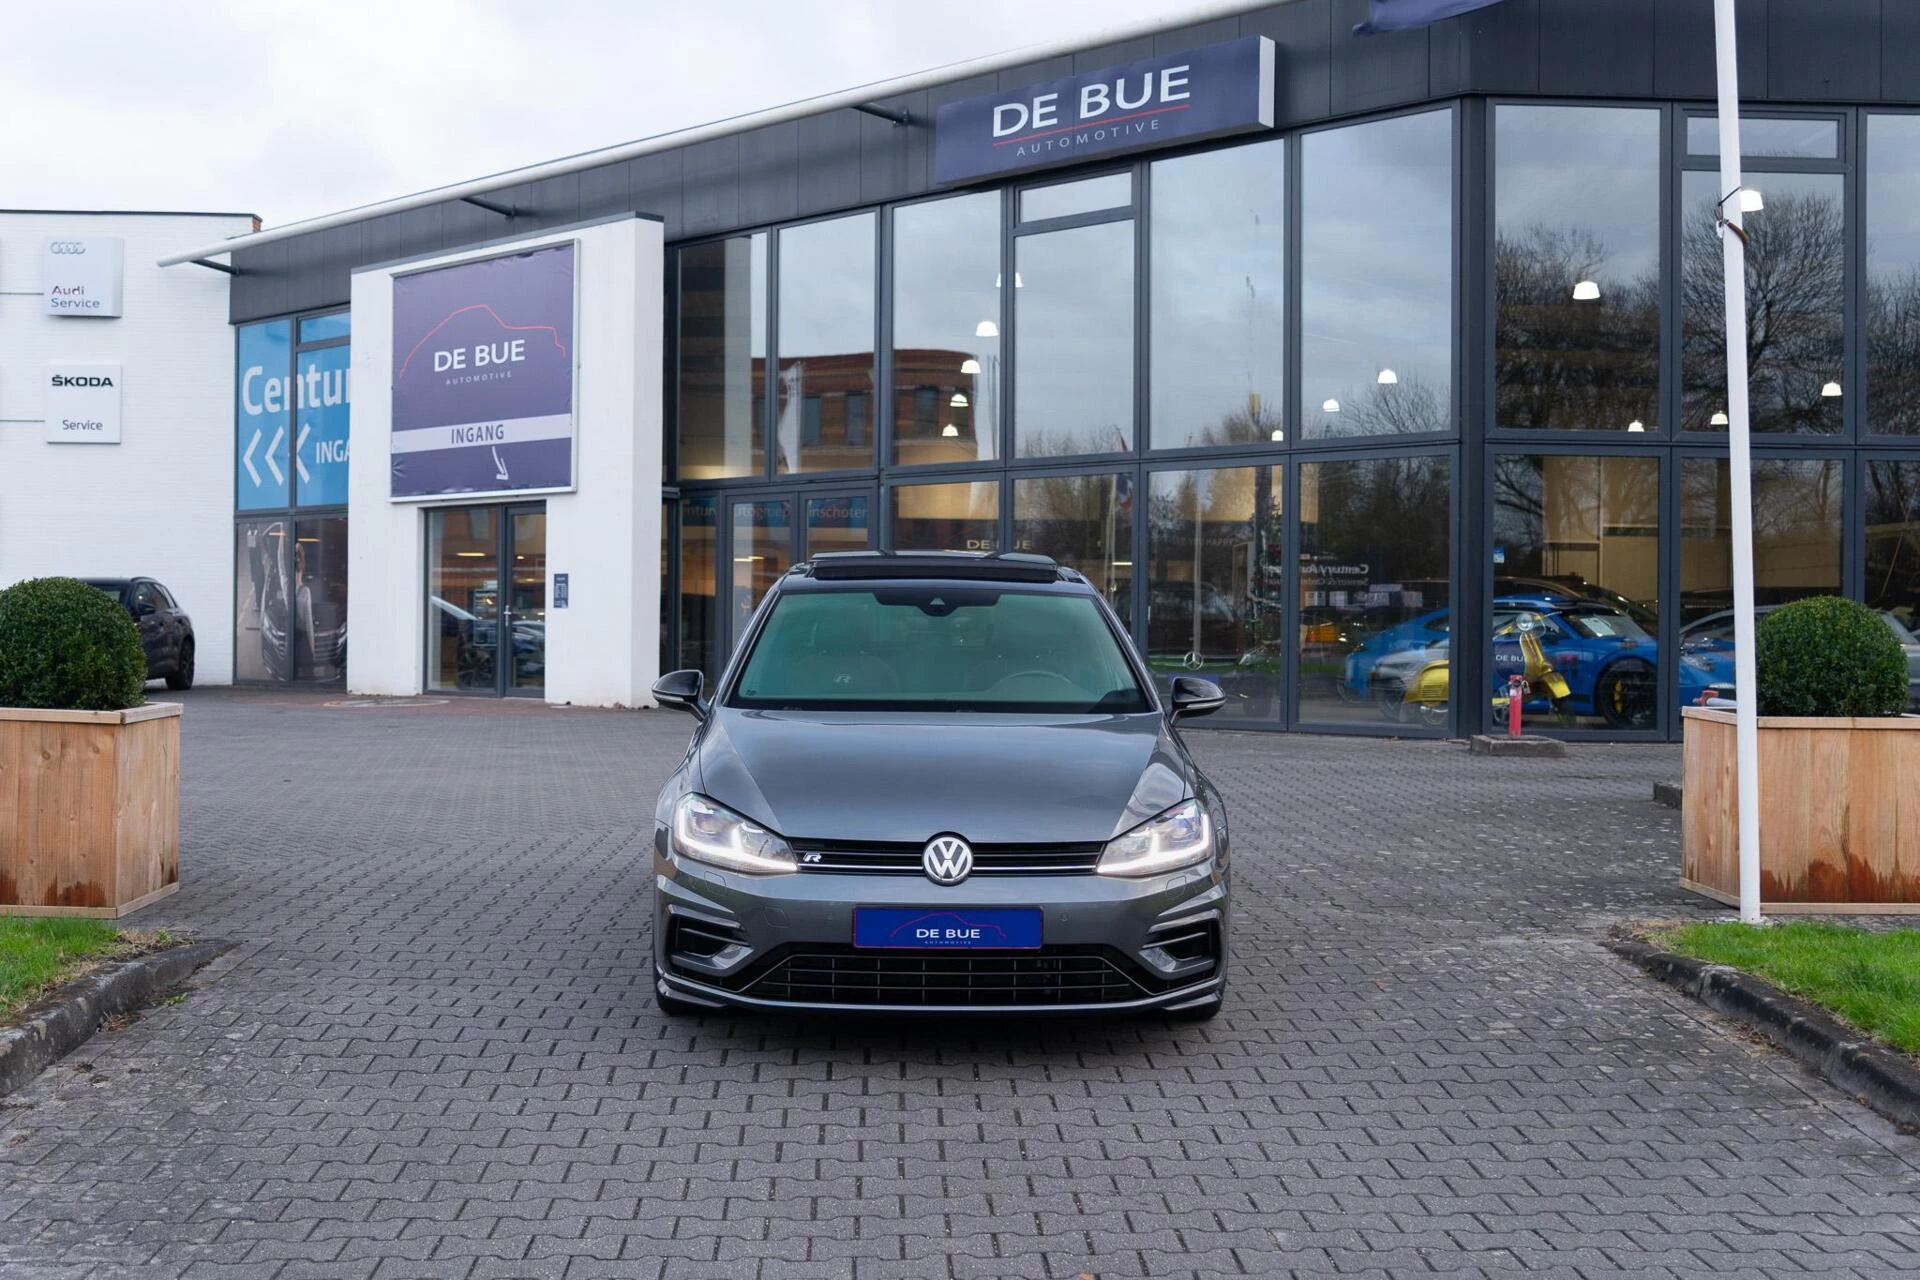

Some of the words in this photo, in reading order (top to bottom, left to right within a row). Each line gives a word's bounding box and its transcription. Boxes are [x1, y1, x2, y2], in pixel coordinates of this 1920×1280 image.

[993, 93, 1059, 138] DE
[1080, 65, 1191, 119] BUE
[1016, 119, 1160, 157] AUTOMOTIVE
[51, 285, 85, 296] Audi
[51, 297, 101, 309] Service
[434, 348, 467, 372] DE
[475, 339, 526, 367] BUE
[51, 374, 114, 388] ŠKODA
[445, 370, 513, 385] AUTOMOTIVE
[242, 363, 351, 416] Centu
[62, 419, 104, 431] Service
[450, 424, 505, 445] INGANG
[315, 439, 350, 465] INGA
[966, 540, 990, 550] DE
[1511, 655, 1525, 663] BU
[802, 852, 822, 863] R
[916, 928, 940, 939] DE
[945, 928, 981, 939] BUE
